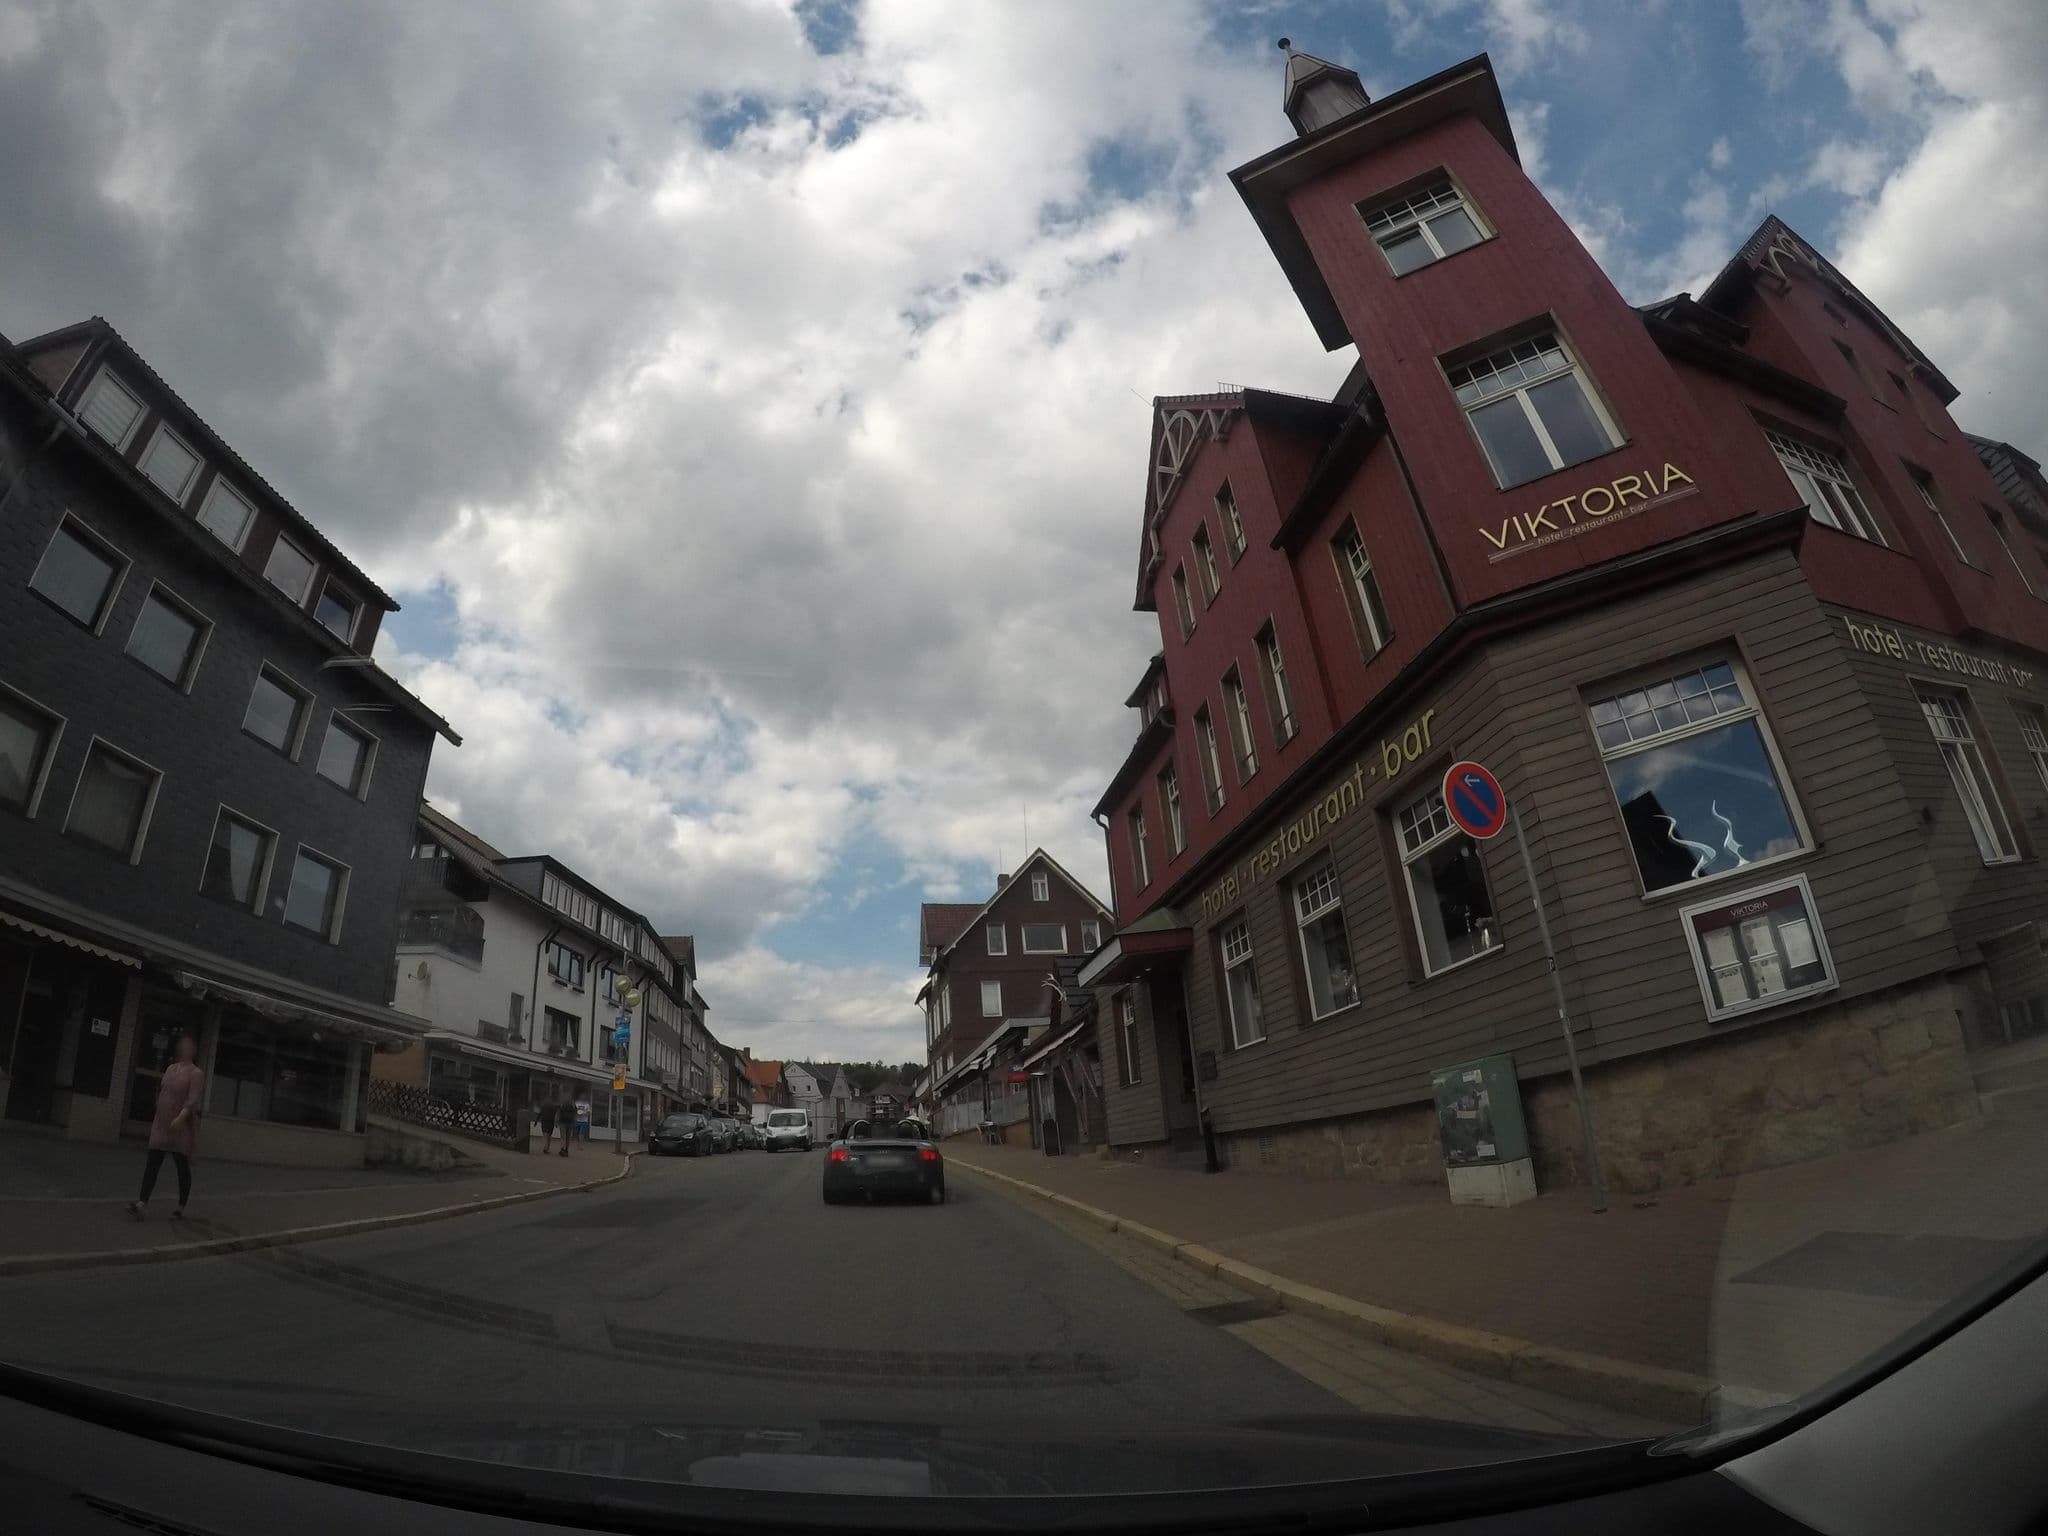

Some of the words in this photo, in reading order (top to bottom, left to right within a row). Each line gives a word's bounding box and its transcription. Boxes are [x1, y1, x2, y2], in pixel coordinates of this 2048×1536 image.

[1479, 463, 1694, 549] VIKTORIA
[1538, 530, 1564, 546] hotel
[1569, 510, 1624, 537] restaurant
[1629, 501, 1648, 515] bar
[1844, 615, 1909, 660] hotel
[1915, 639, 2008, 684] restaurant
[1201, 865, 1240, 921] hotel
[1250, 763, 1363, 882] restaurant
[1382, 709, 1436, 778] bar
[1730, 900, 1768, 917] VIKTORIA
